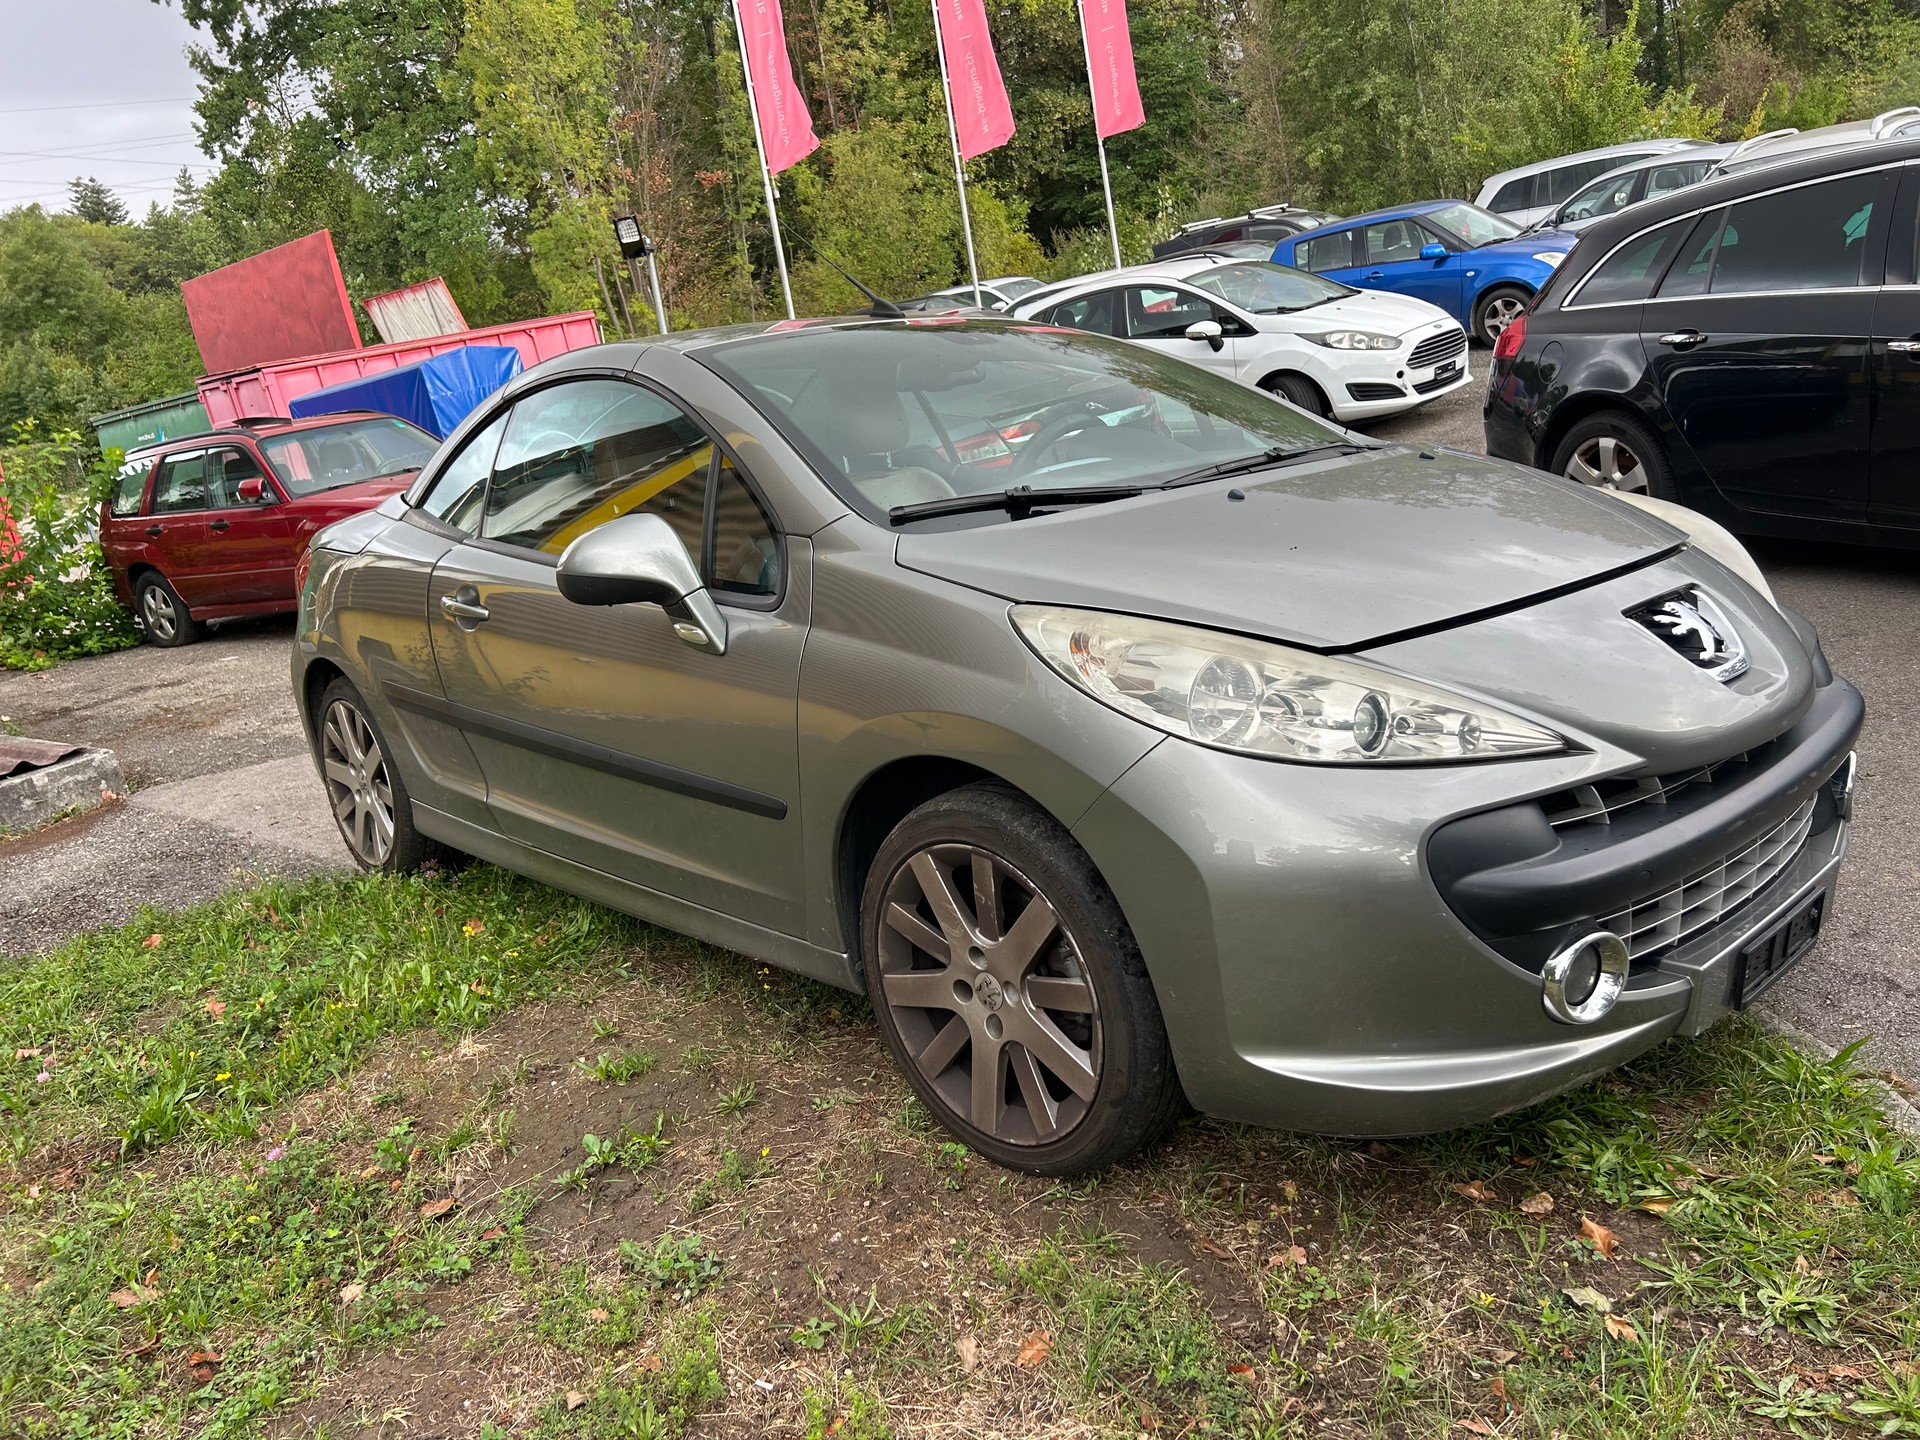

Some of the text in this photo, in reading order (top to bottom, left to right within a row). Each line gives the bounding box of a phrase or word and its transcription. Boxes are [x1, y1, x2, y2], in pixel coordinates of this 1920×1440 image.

[767, 50, 790, 146] wir-bringens.ch
[966, 51, 990, 134] wir-bringens.ch
[1106, 42, 1121, 116] wir-bringens.ch
